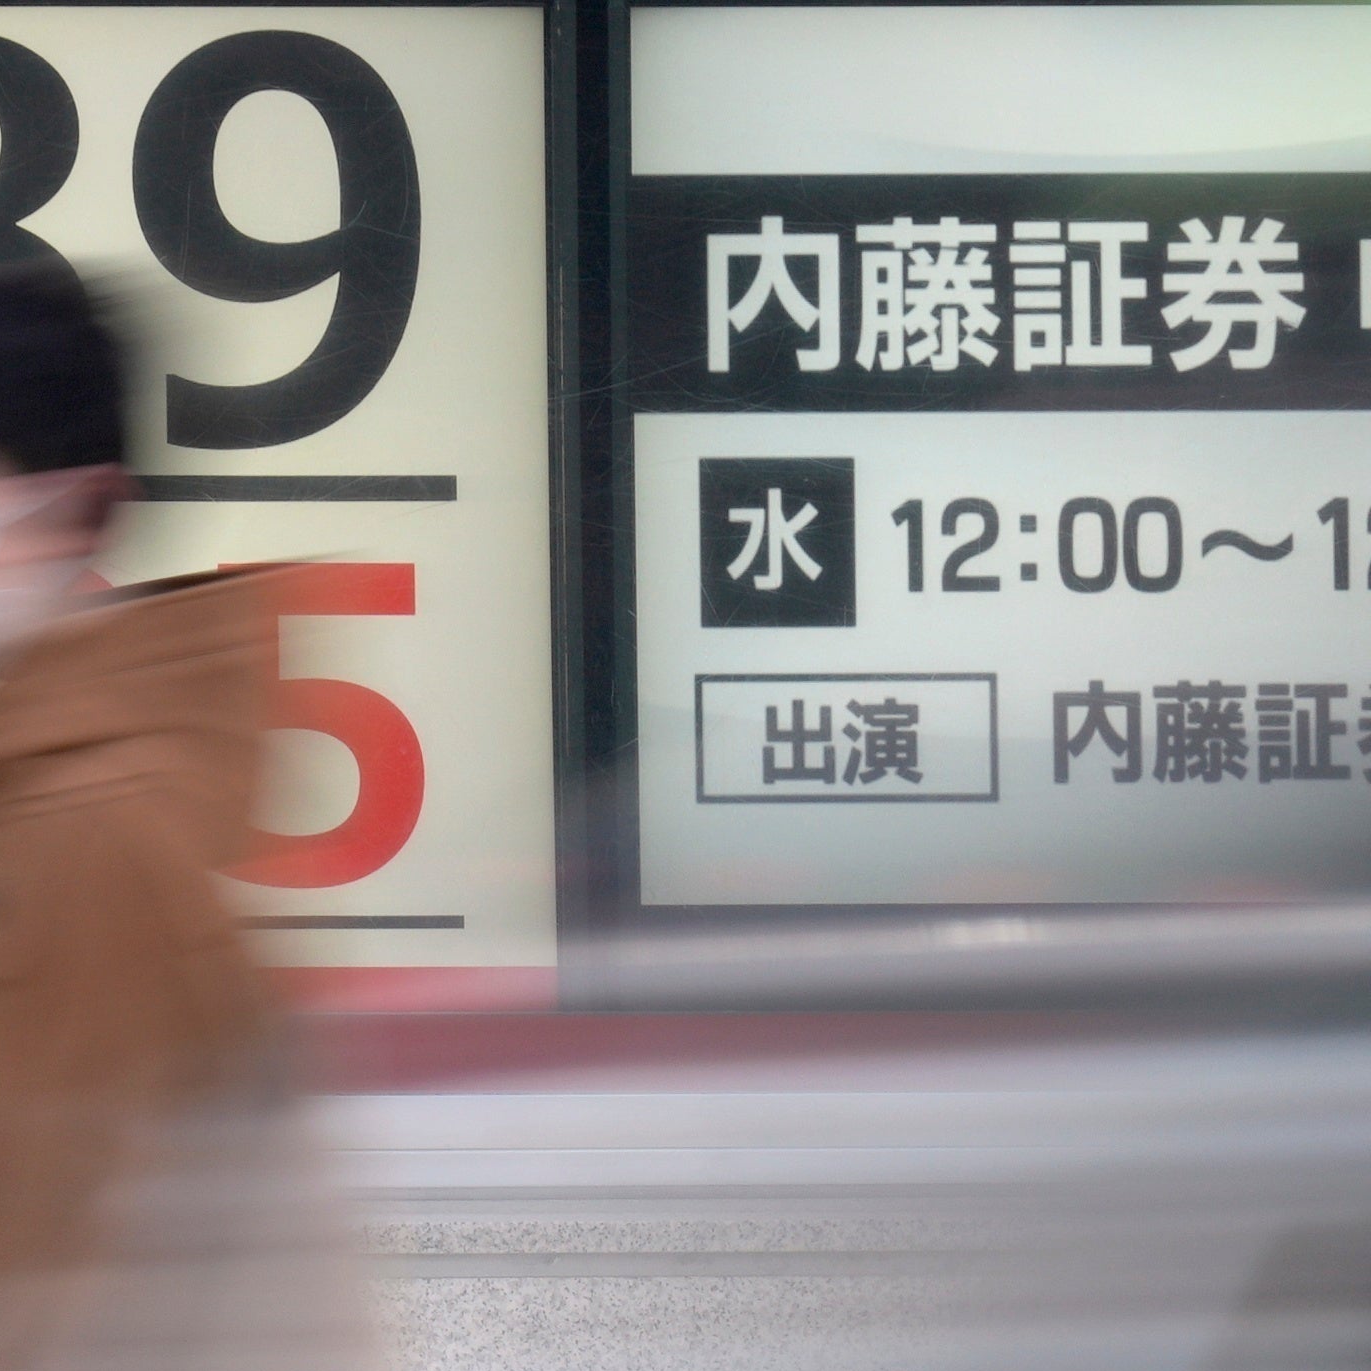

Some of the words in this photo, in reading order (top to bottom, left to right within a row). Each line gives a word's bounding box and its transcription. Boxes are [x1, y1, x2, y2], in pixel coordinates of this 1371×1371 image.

[706, 216, 1307, 373] 内藤証券
[726, 488, 824, 591] 水
[761, 697, 925, 786] 出演
[1053, 680, 1371, 784] 内藤証
